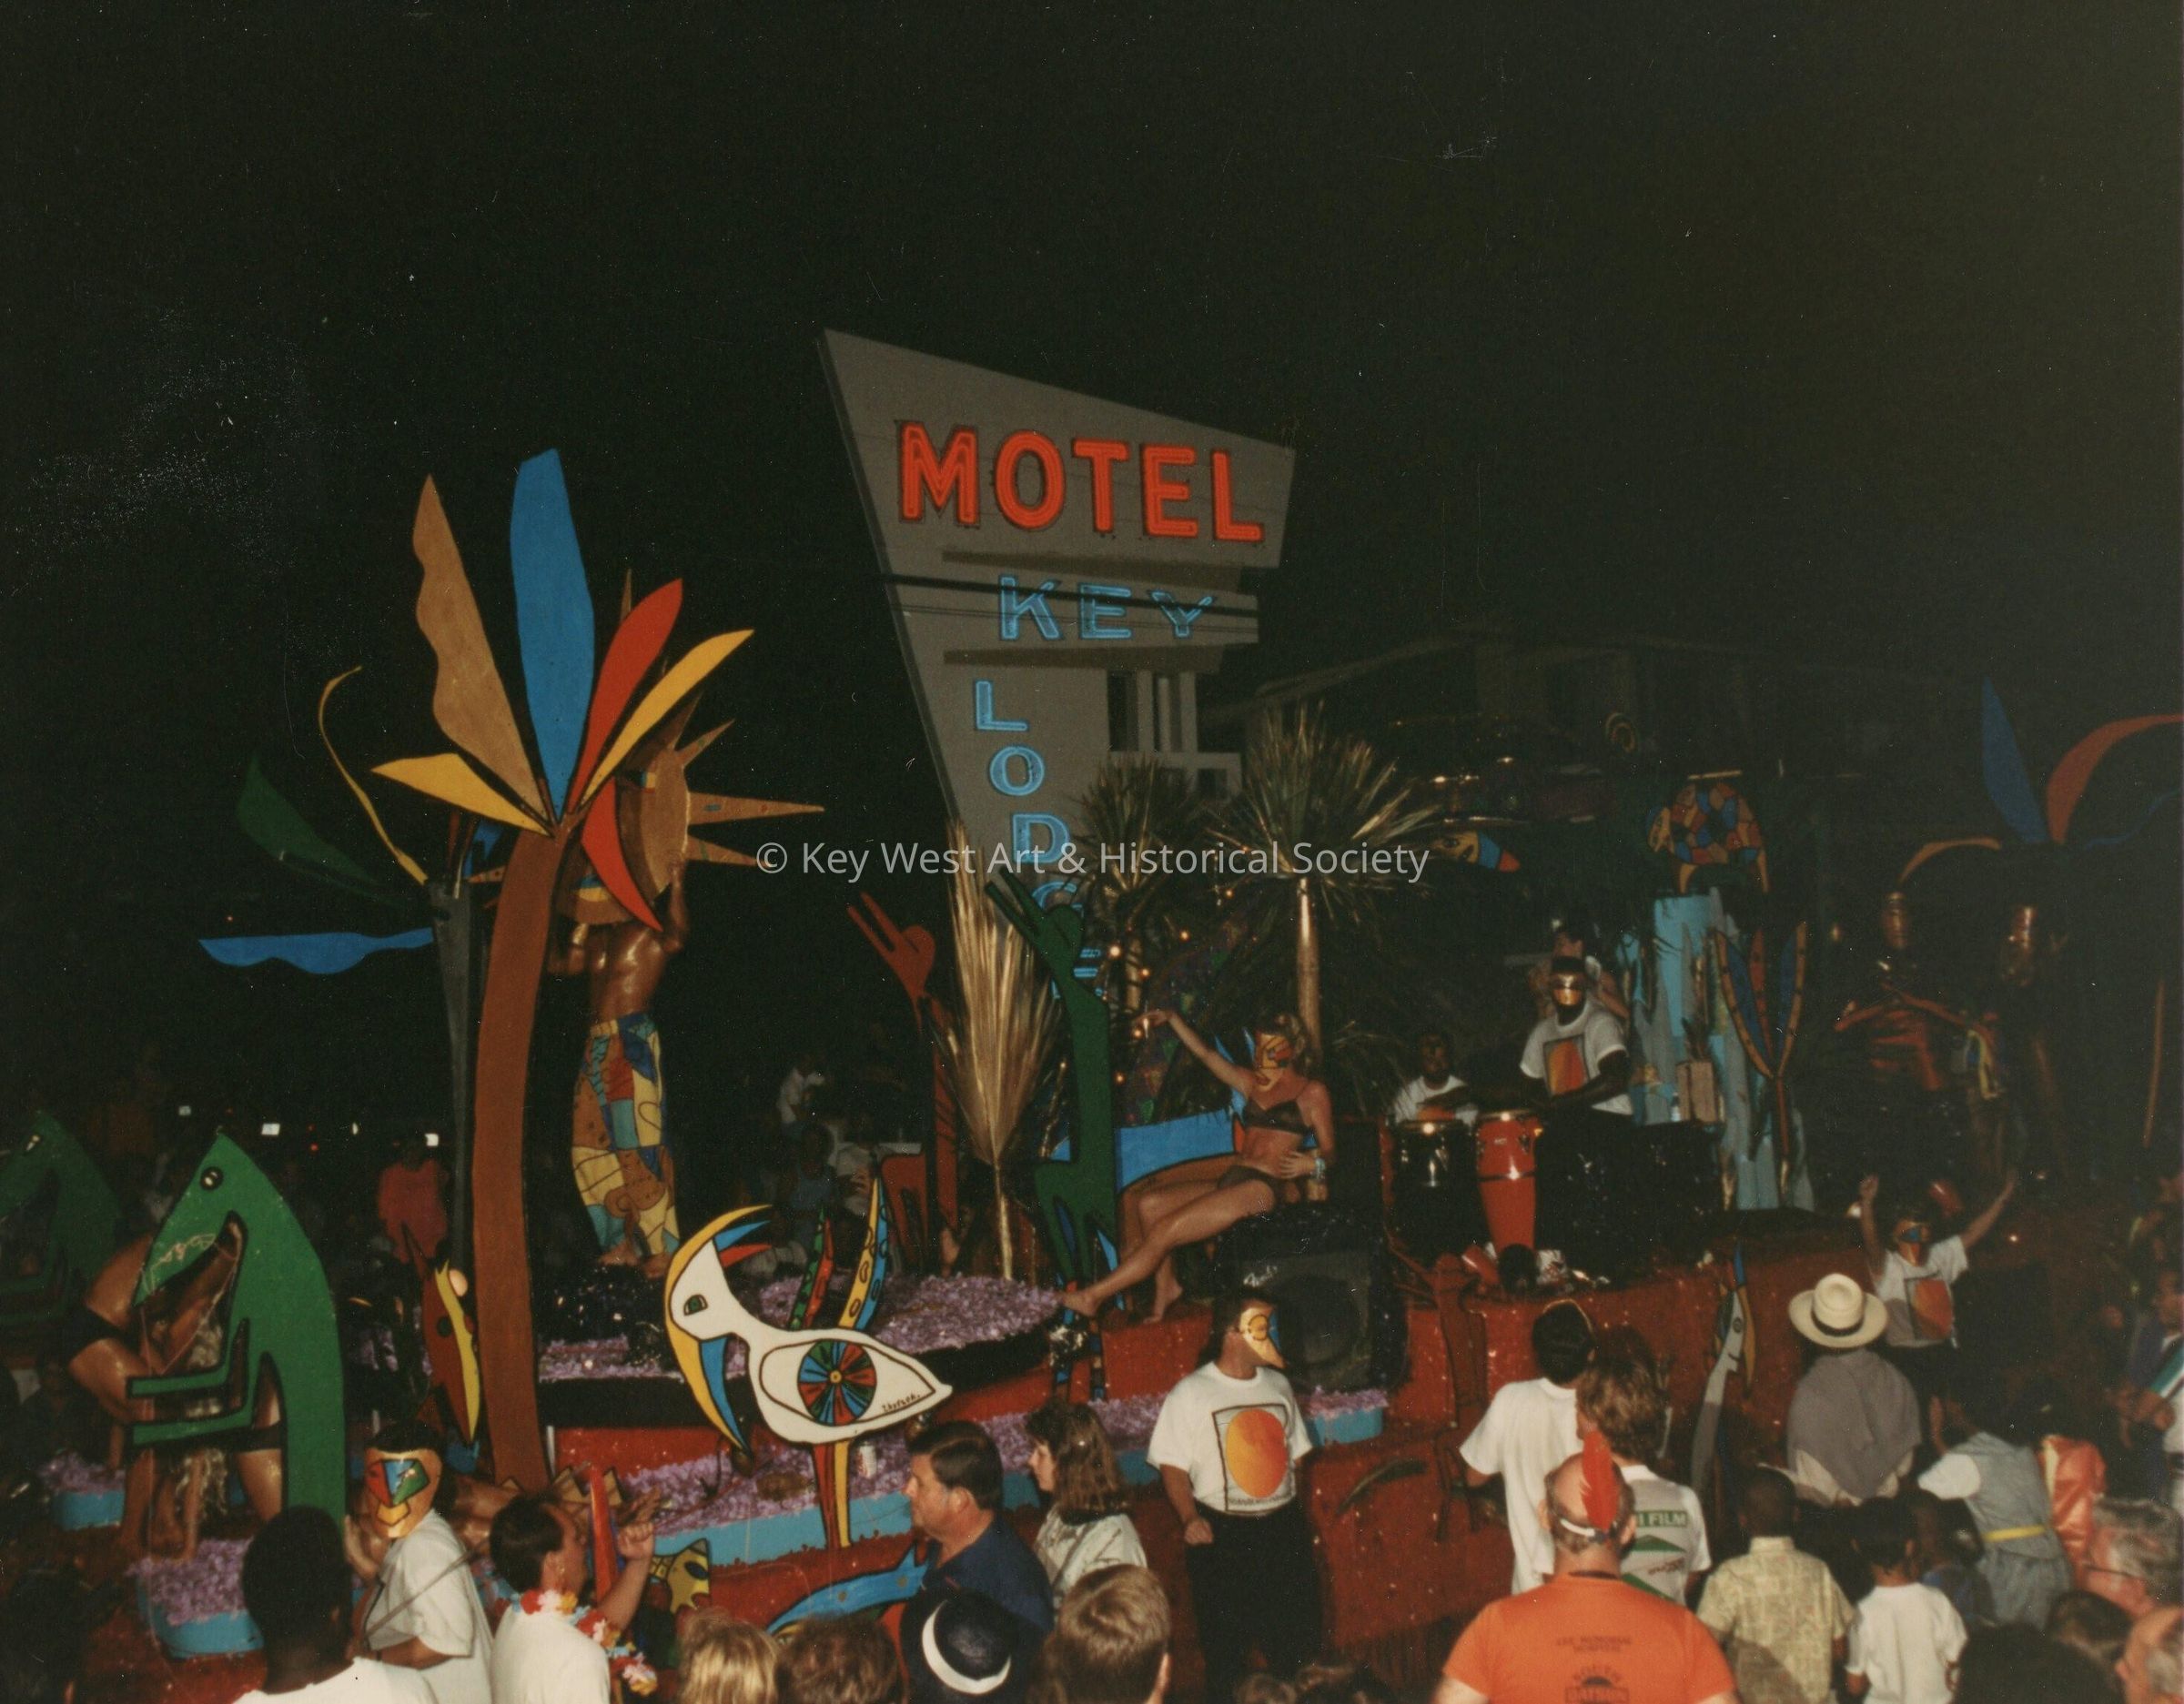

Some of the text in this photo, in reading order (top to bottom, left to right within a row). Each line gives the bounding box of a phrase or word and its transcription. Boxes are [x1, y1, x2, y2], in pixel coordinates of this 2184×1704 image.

[900, 421, 1264, 542] MOTEL
[999, 575, 1215, 640] KEY
[1648, 1512, 1686, 1527] FILM
